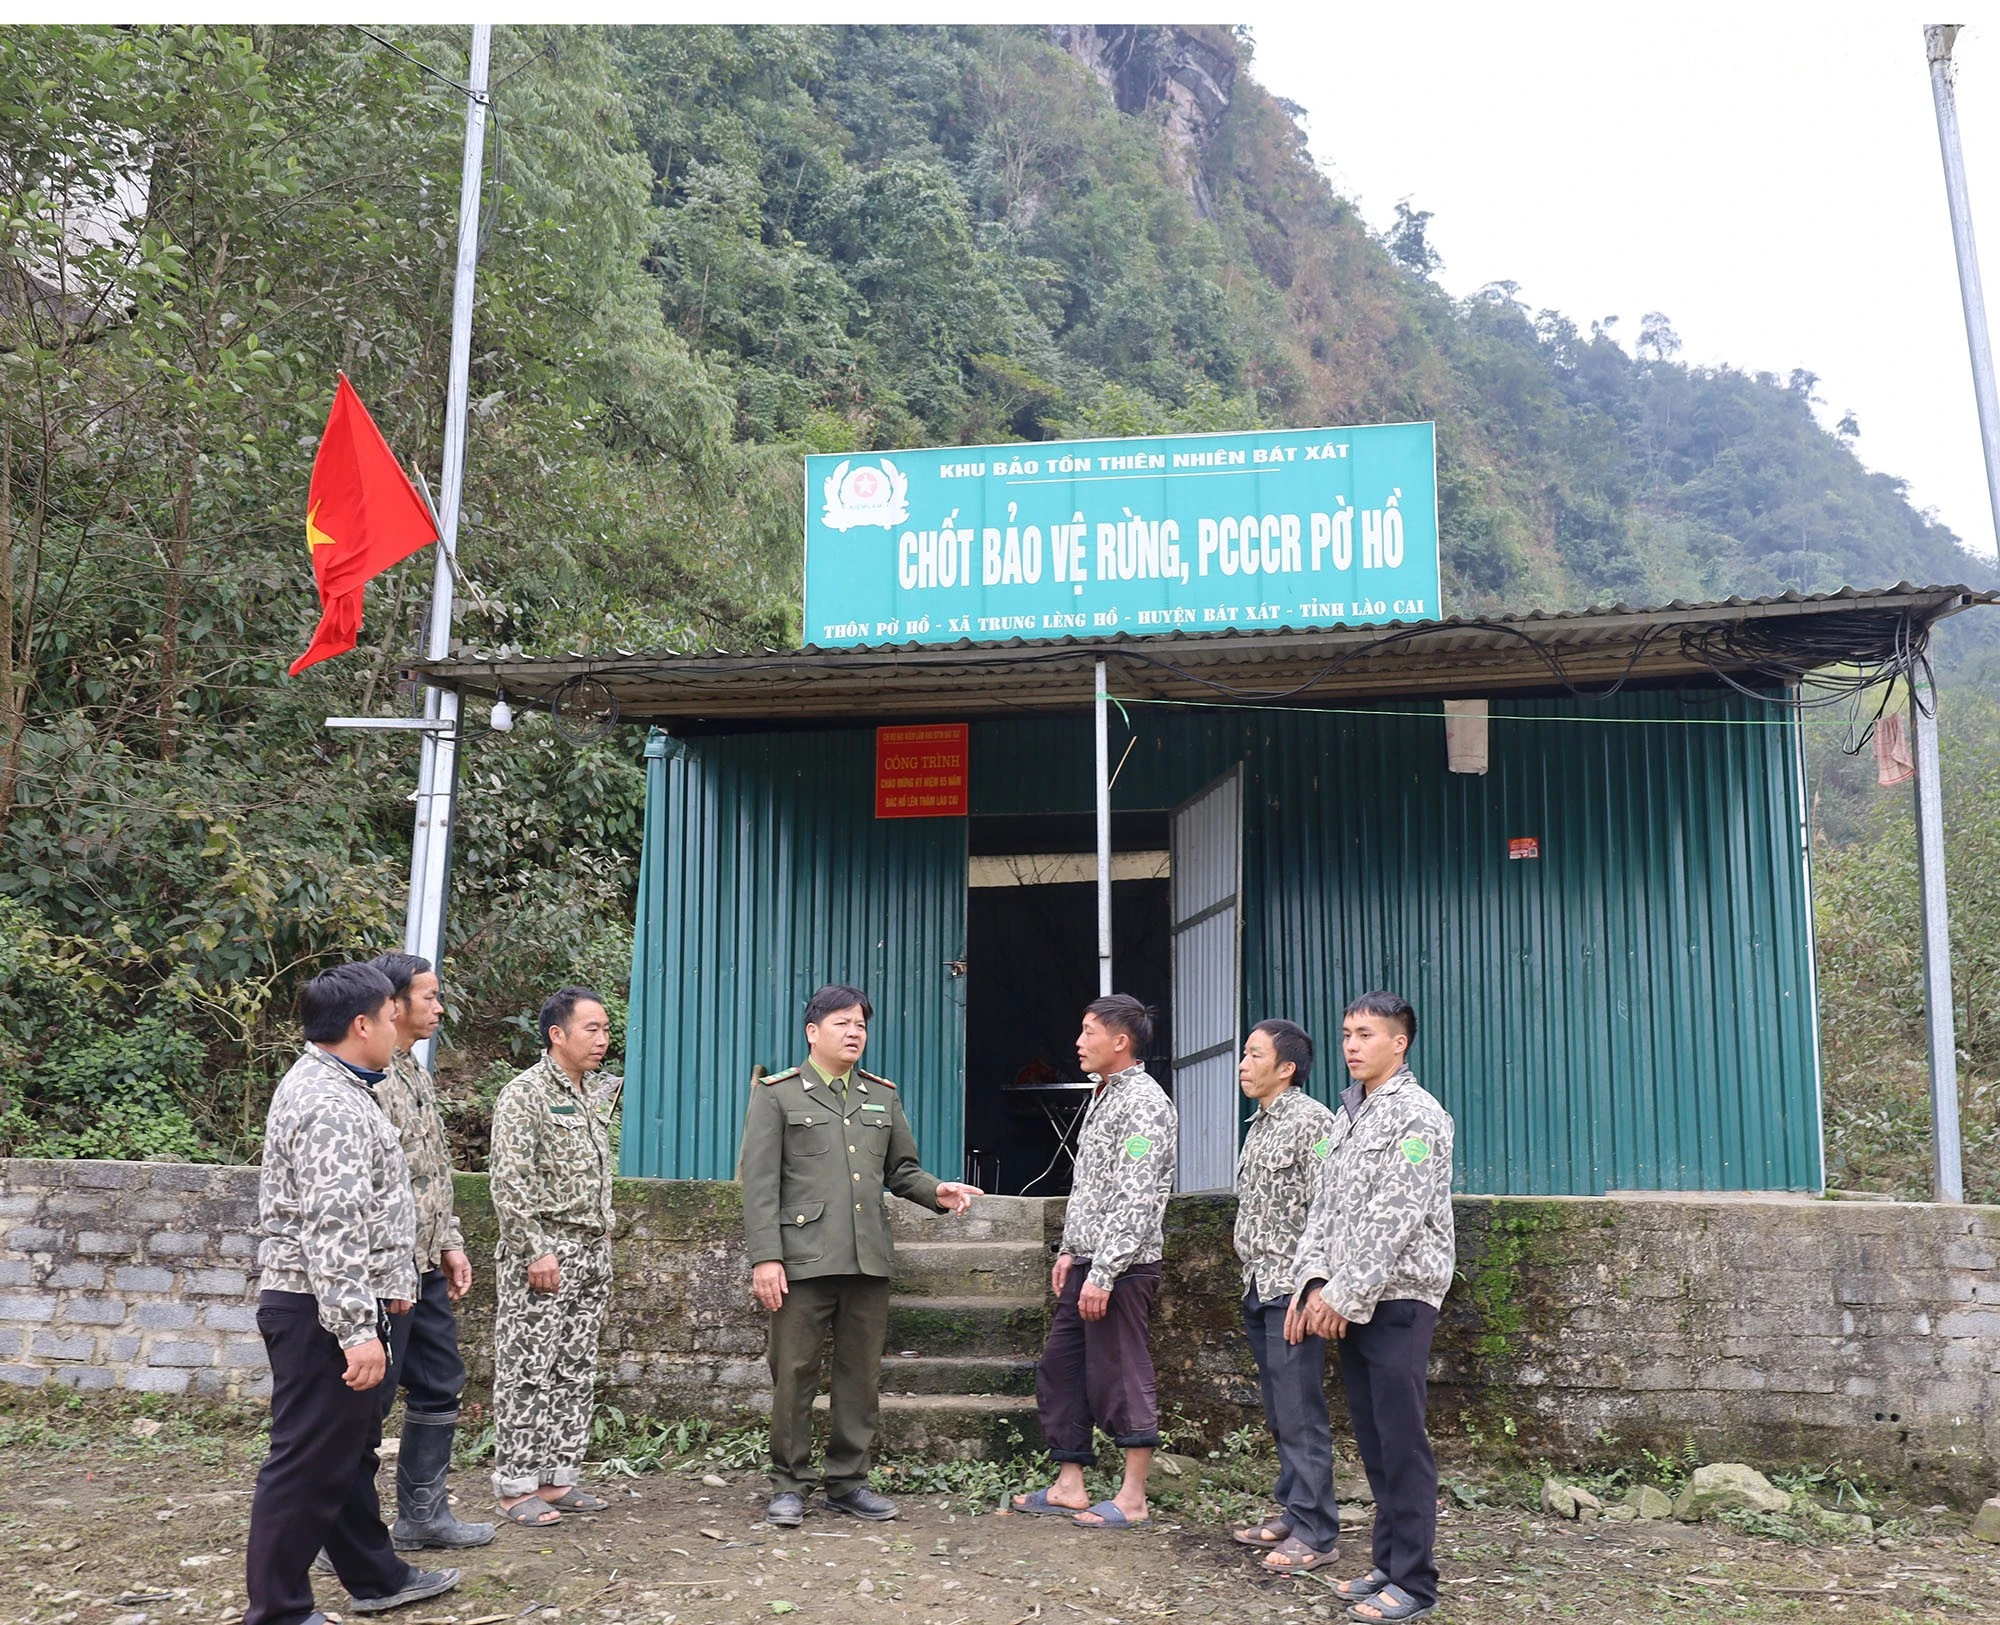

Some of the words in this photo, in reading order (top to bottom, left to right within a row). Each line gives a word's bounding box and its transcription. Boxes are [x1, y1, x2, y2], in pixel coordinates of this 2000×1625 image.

[940, 463, 985, 478] KHU
[993, 456, 1038, 475] BẢO
[1046, 455, 1090, 473] TỒN
[1098, 453, 1165, 470] THIÊN
[1173, 449, 1245, 467] NHIÊN
[1253, 446, 1297, 462] BÁT
[1305, 442, 1349, 460] XÁT
[899, 508, 974, 589] CHỐT
[983, 502, 1042, 585] BẢO
[1051, 512, 1087, 595] VỆ
[1097, 507, 1189, 584] RỪNG,
[1199, 514, 1302, 576] PCCCR
[1311, 495, 1353, 570] PỜ
[1362, 488, 1404, 568] HỒ
[824, 621, 869, 638] THÔN
[877, 618, 899, 635] PỜ
[906, 615, 929, 634] HỒ
[949, 615, 970, 631] XÃ
[978, 616, 1035, 630] TRUNG
[1043, 611, 1086, 628] LÈNG
[1094, 607, 1118, 625] HỒ
[1138, 607, 1195, 626] HUYỆN
[1204, 604, 1238, 621] BÁT
[1246, 603, 1280, 619] XÁT
[1300, 598, 1344, 617] TỈNH
[1352, 598, 1386, 615] LÀO
[1393, 600, 1424, 614] CAI
[884, 754, 918, 771] CÔNG
[921, 752, 960, 769] TRÌNH
